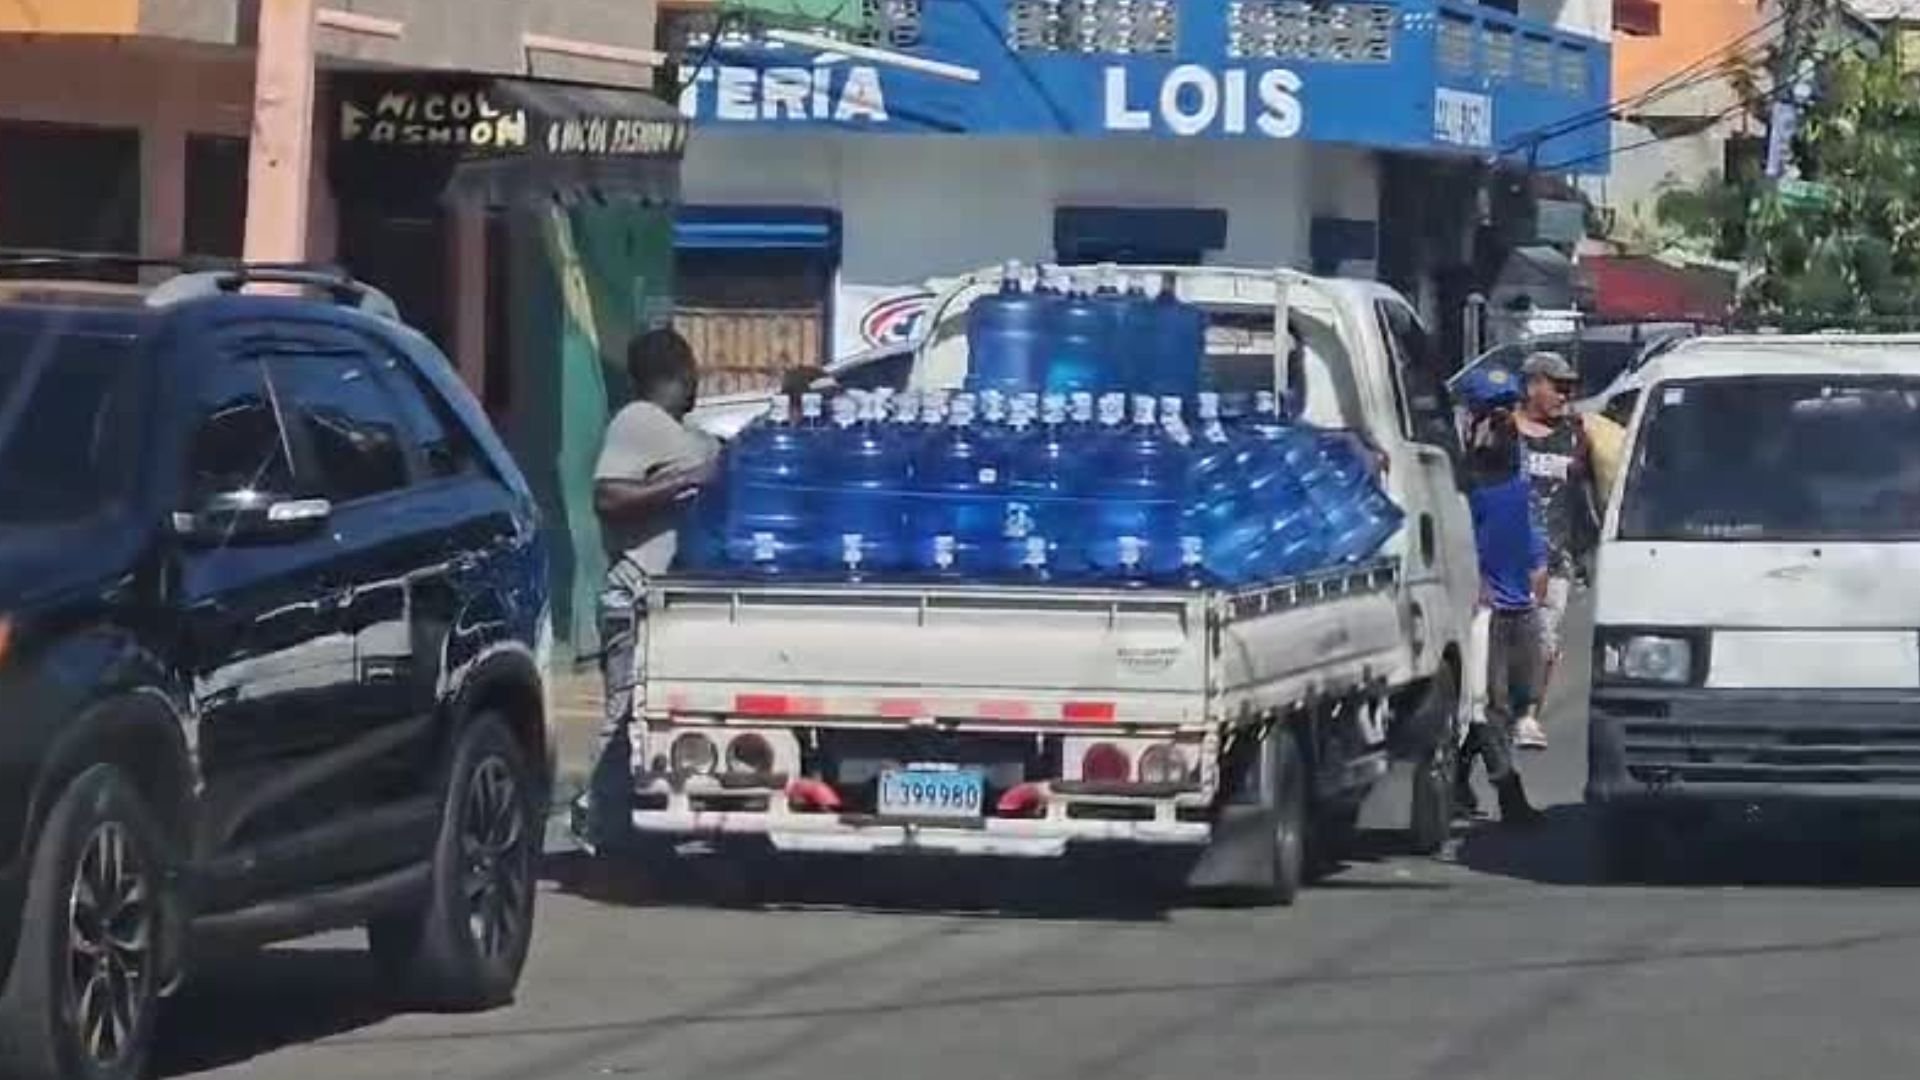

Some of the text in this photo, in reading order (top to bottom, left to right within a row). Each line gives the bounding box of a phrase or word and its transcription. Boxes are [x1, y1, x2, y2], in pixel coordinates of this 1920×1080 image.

[376, 91, 499, 121] NICOL
[1105, 64, 1303, 138] LOIS
[341, 102, 526, 146] FASHION
